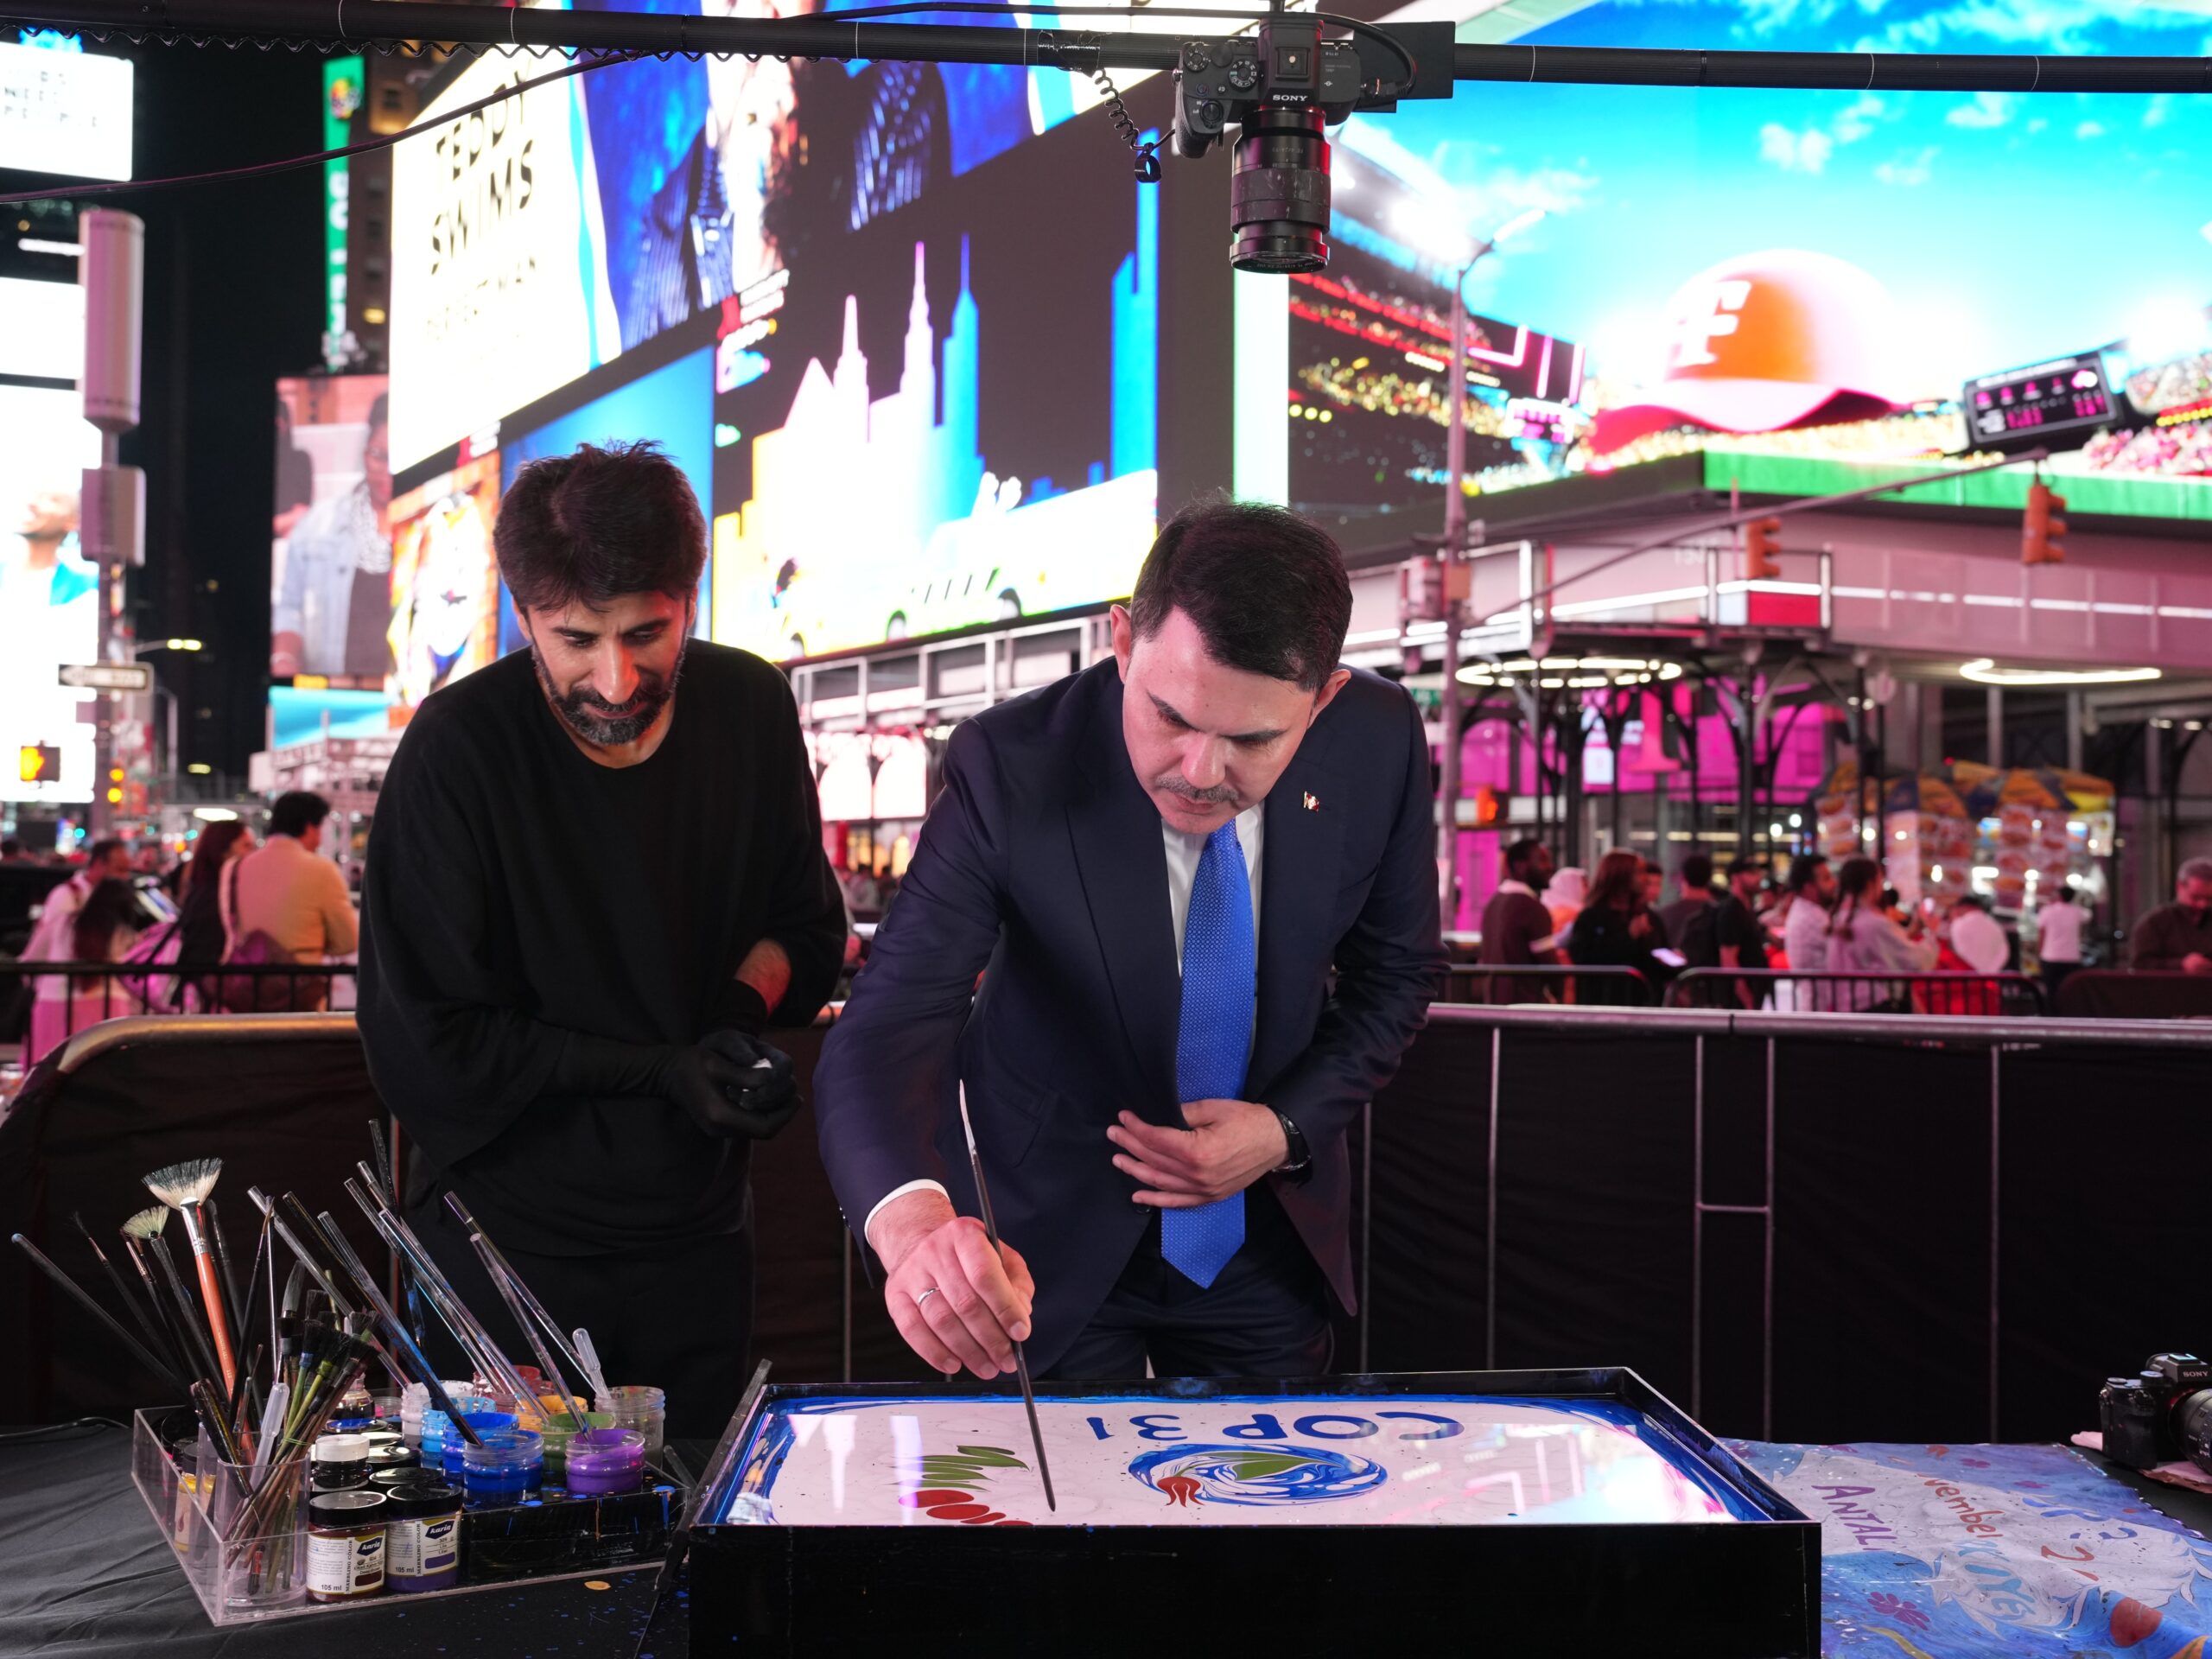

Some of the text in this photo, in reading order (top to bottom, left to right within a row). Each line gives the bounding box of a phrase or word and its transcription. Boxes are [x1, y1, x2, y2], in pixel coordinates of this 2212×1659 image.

[431, 140, 533, 275] SWIMS
[1086, 1412, 1465, 1441] COP 31
[429, 1524, 451, 1534] karin
[361, 1541, 381, 1550] karin
